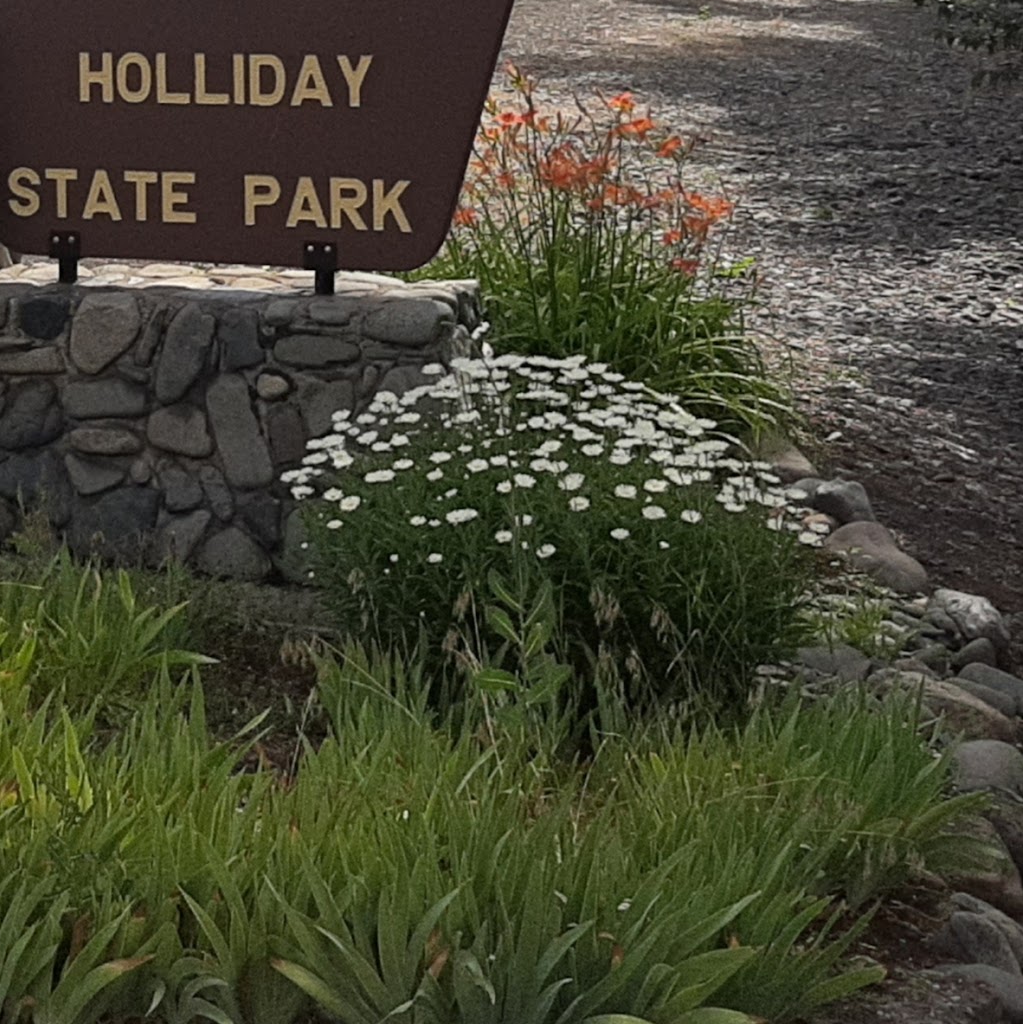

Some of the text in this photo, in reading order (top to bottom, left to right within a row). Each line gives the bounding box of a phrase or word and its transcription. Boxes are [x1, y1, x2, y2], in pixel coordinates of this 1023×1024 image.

[78, 52, 374, 108] HOLLIDAY
[7, 167, 412, 234] STATE PARK
